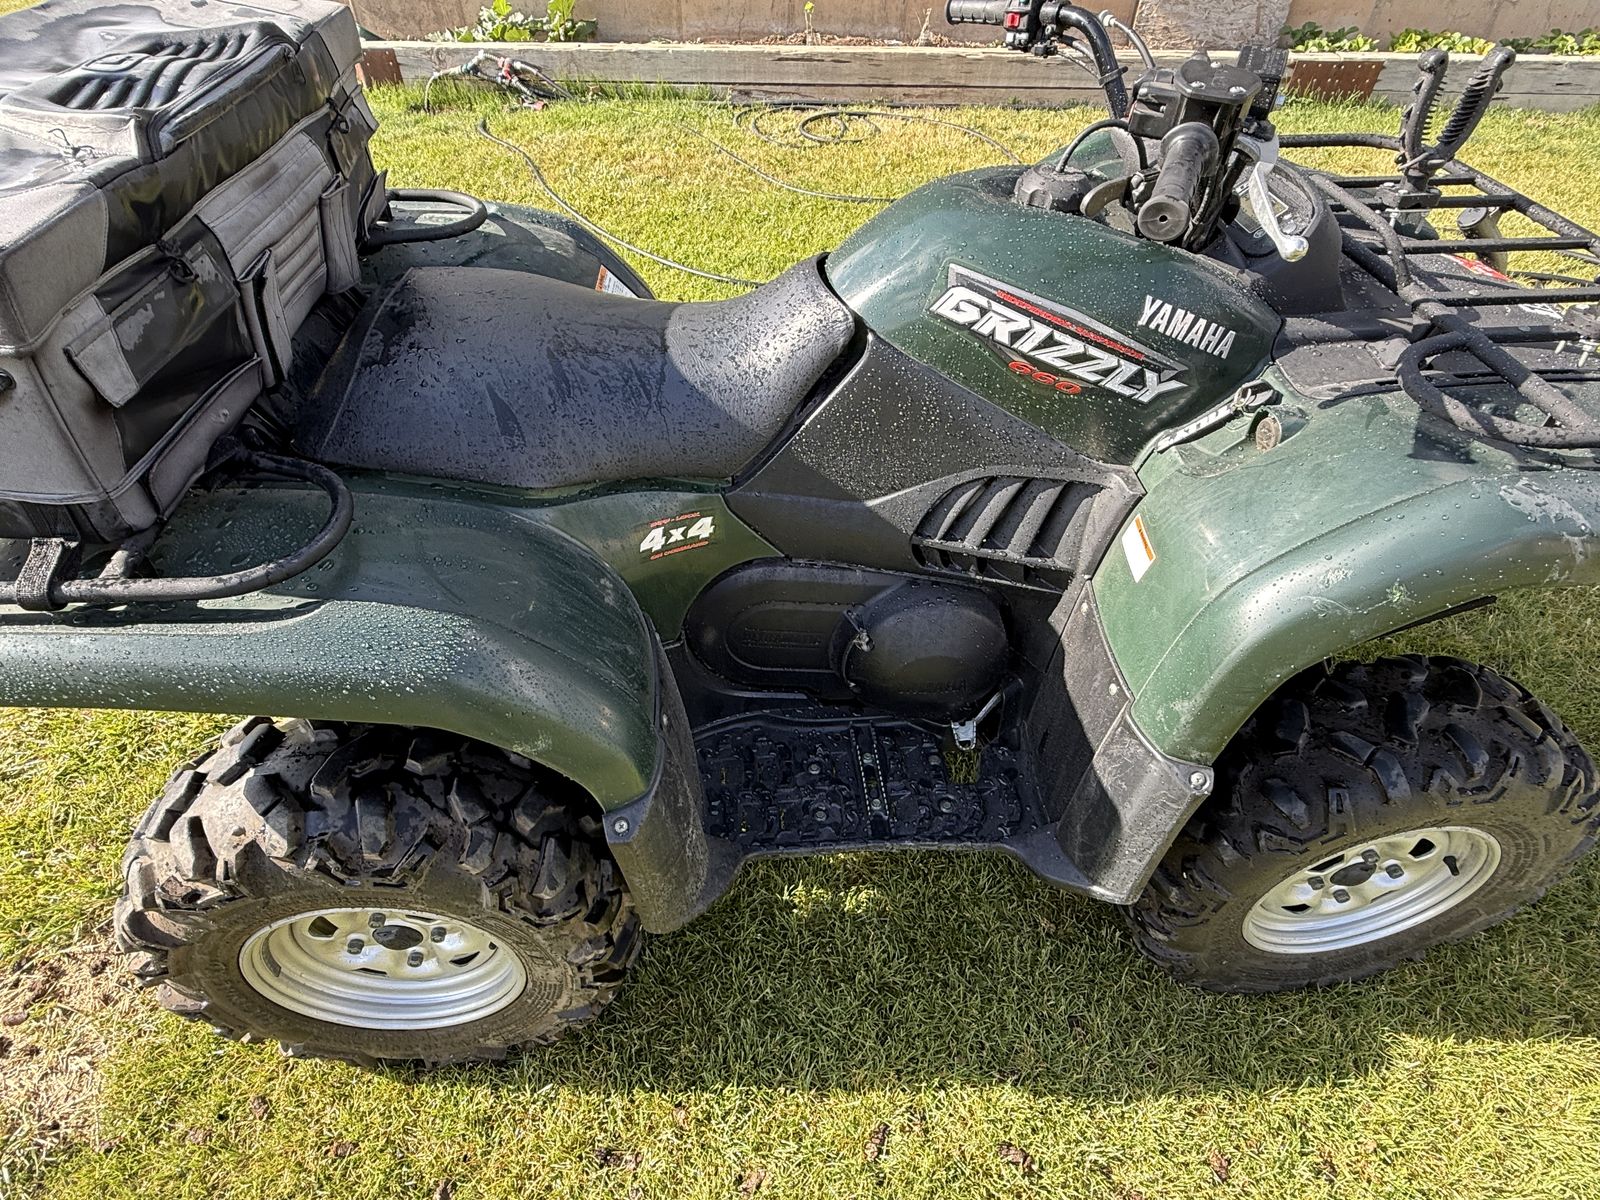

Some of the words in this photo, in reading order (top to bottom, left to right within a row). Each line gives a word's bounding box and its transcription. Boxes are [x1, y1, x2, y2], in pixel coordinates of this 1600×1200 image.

[929, 286, 1188, 403] GRIZZLY
[1137, 294, 1237, 359] YAMAHA
[1007, 360, 1082, 394] 660
[640, 516, 715, 552] 4x4
